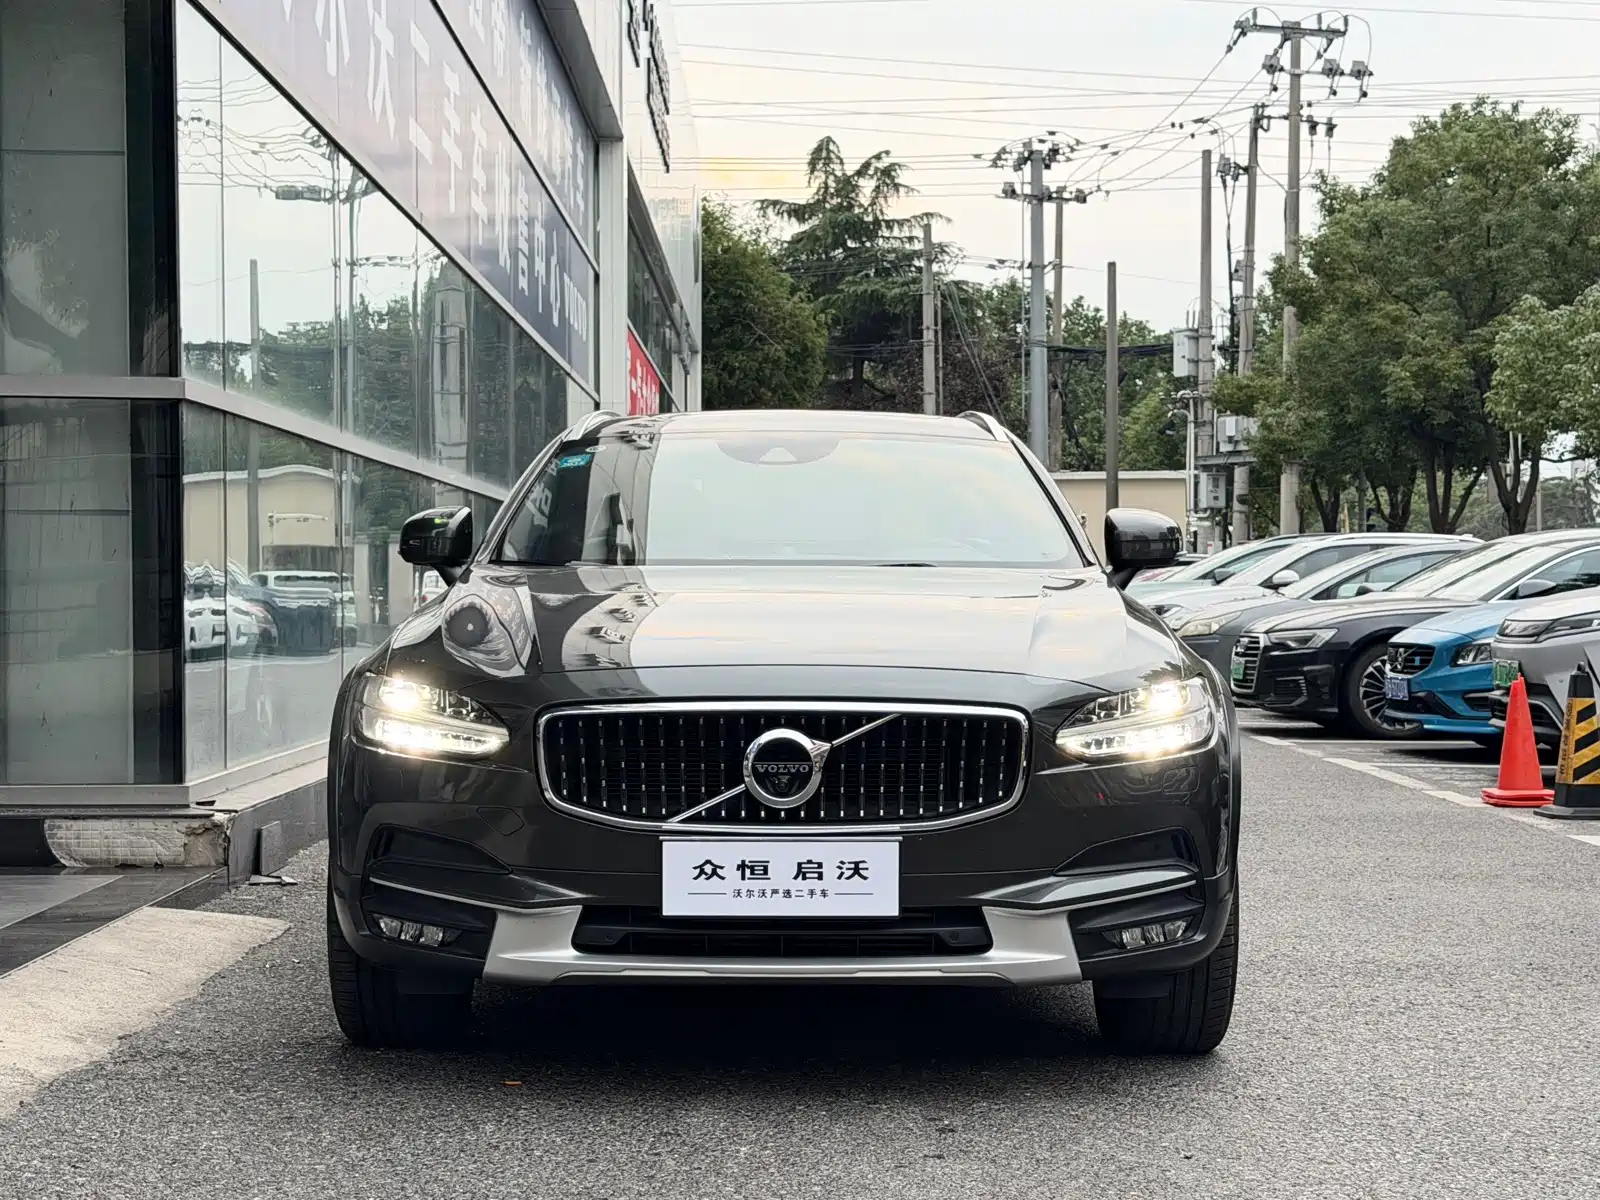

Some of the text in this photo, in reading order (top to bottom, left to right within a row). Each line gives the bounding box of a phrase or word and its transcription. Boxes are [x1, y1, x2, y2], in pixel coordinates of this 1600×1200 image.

[754, 764, 810, 773] VOLVO
[732, 888, 830, 900] 沃尔沃严选二手车
